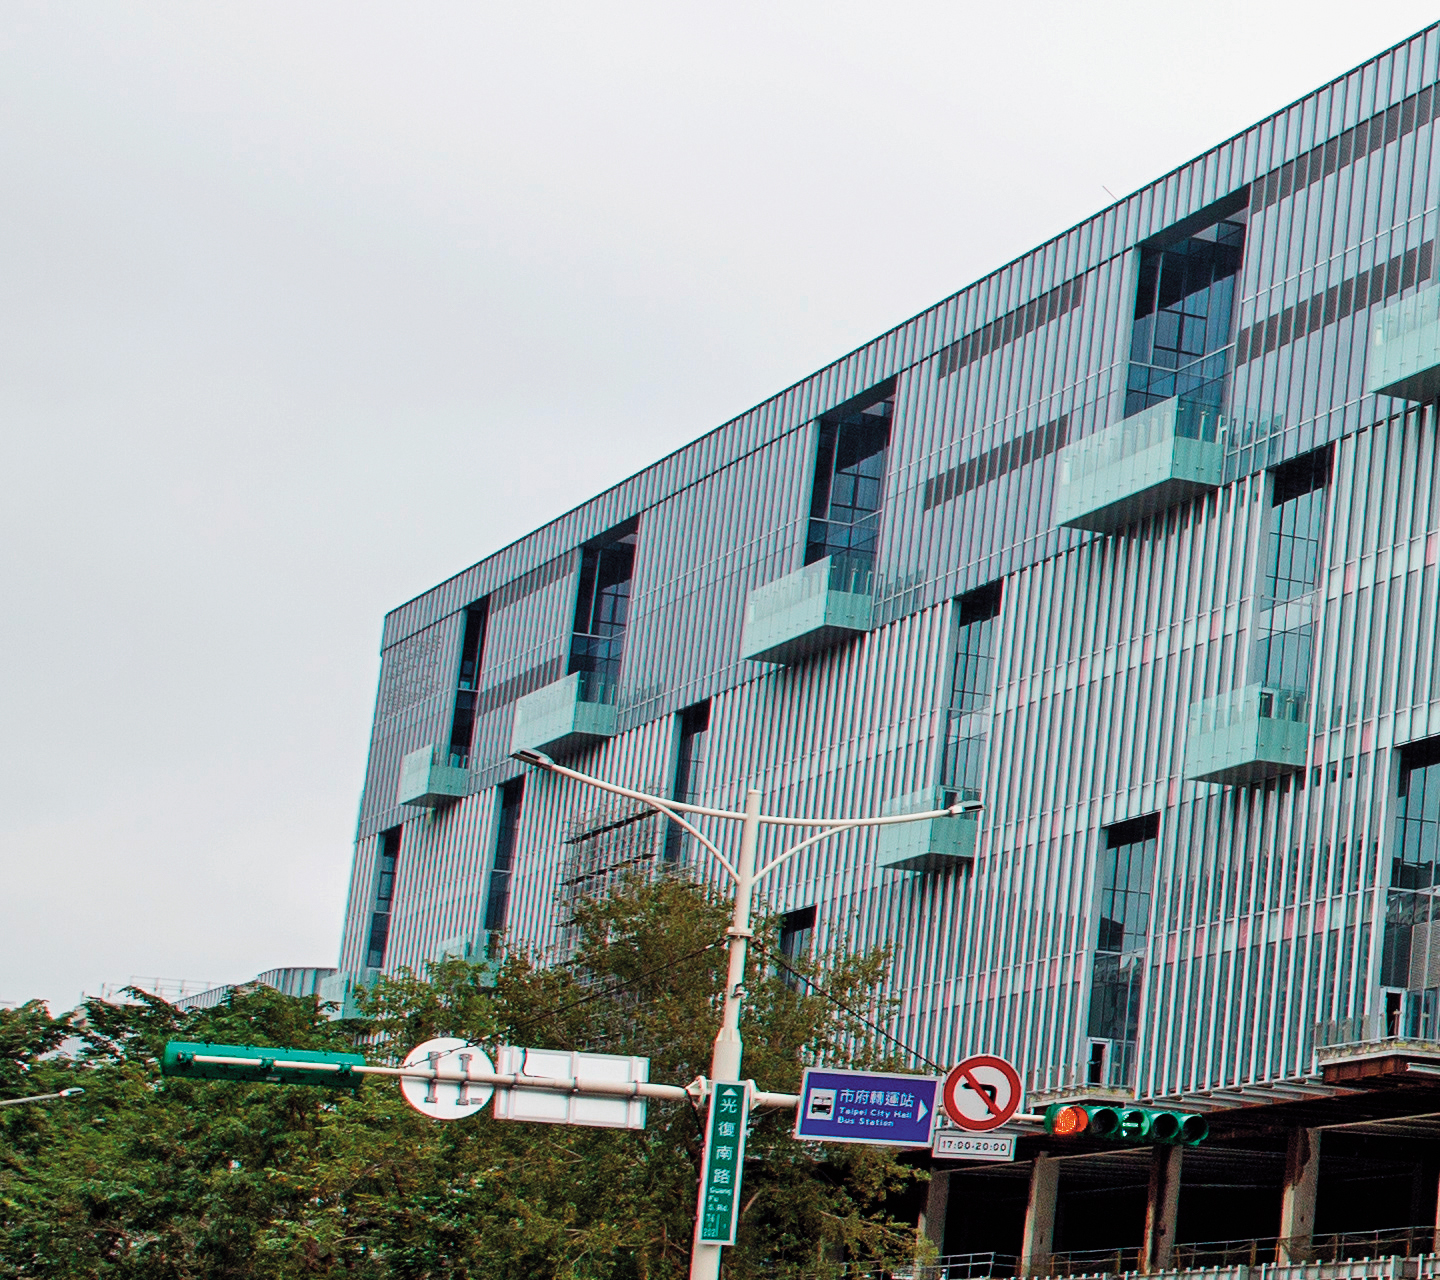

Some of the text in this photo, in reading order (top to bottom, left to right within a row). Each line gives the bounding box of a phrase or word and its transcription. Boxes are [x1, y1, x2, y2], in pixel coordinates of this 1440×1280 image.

[839, 1088, 915, 1108] 市府轉運站
[839, 1106, 912, 1119] Taipei City Hall
[837, 1116, 894, 1127] Bus Station
[712, 1098, 738, 1184] 光復南路
[941, 1140, 1007, 1152] 17:00-20:00
